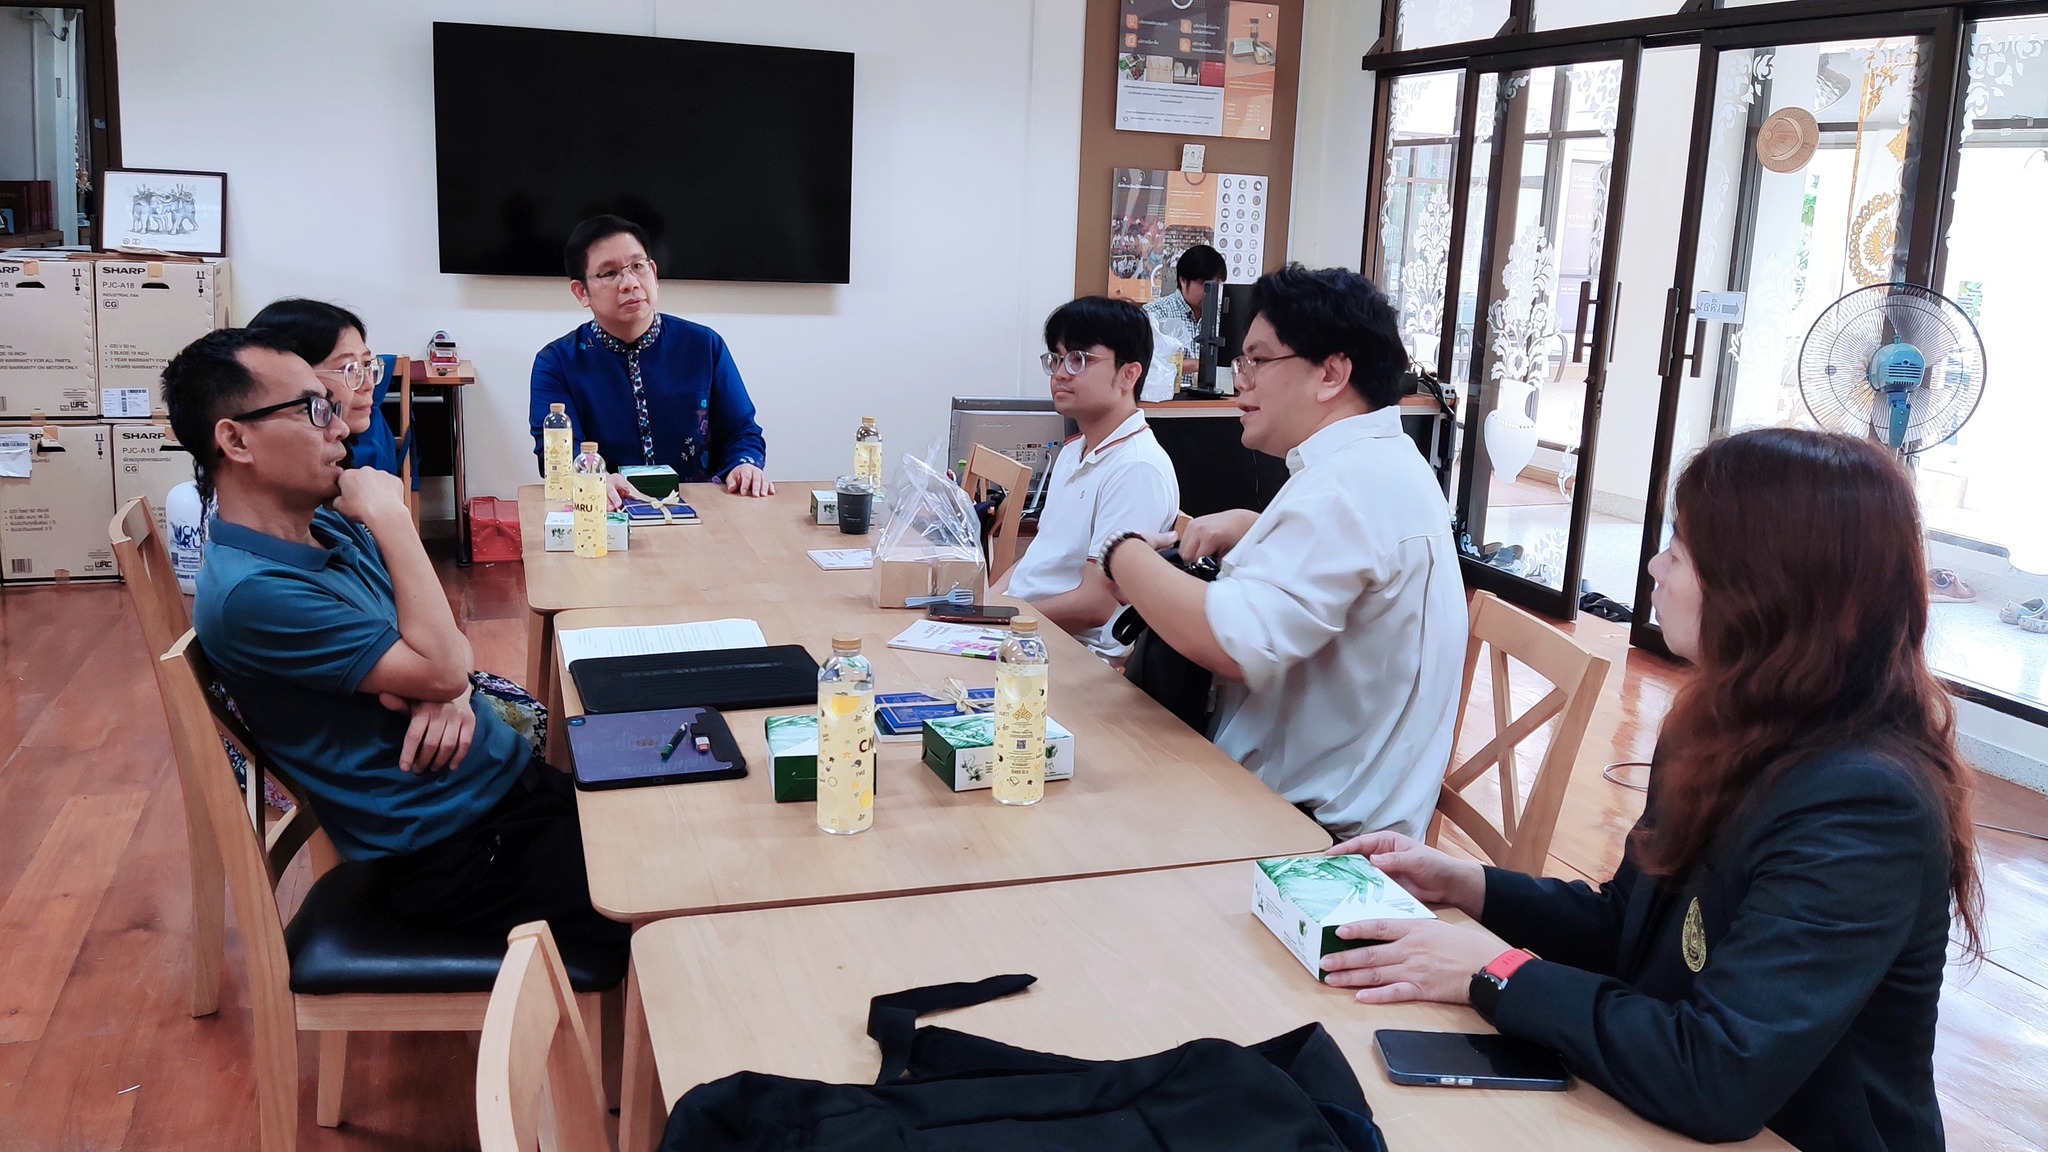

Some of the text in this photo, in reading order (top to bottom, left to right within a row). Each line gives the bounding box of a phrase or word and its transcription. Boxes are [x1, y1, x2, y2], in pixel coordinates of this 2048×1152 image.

[102, 266, 146, 275] SHARP
[102, 281, 135, 289] PJC-A18
[122, 432, 166, 440] SHARP
